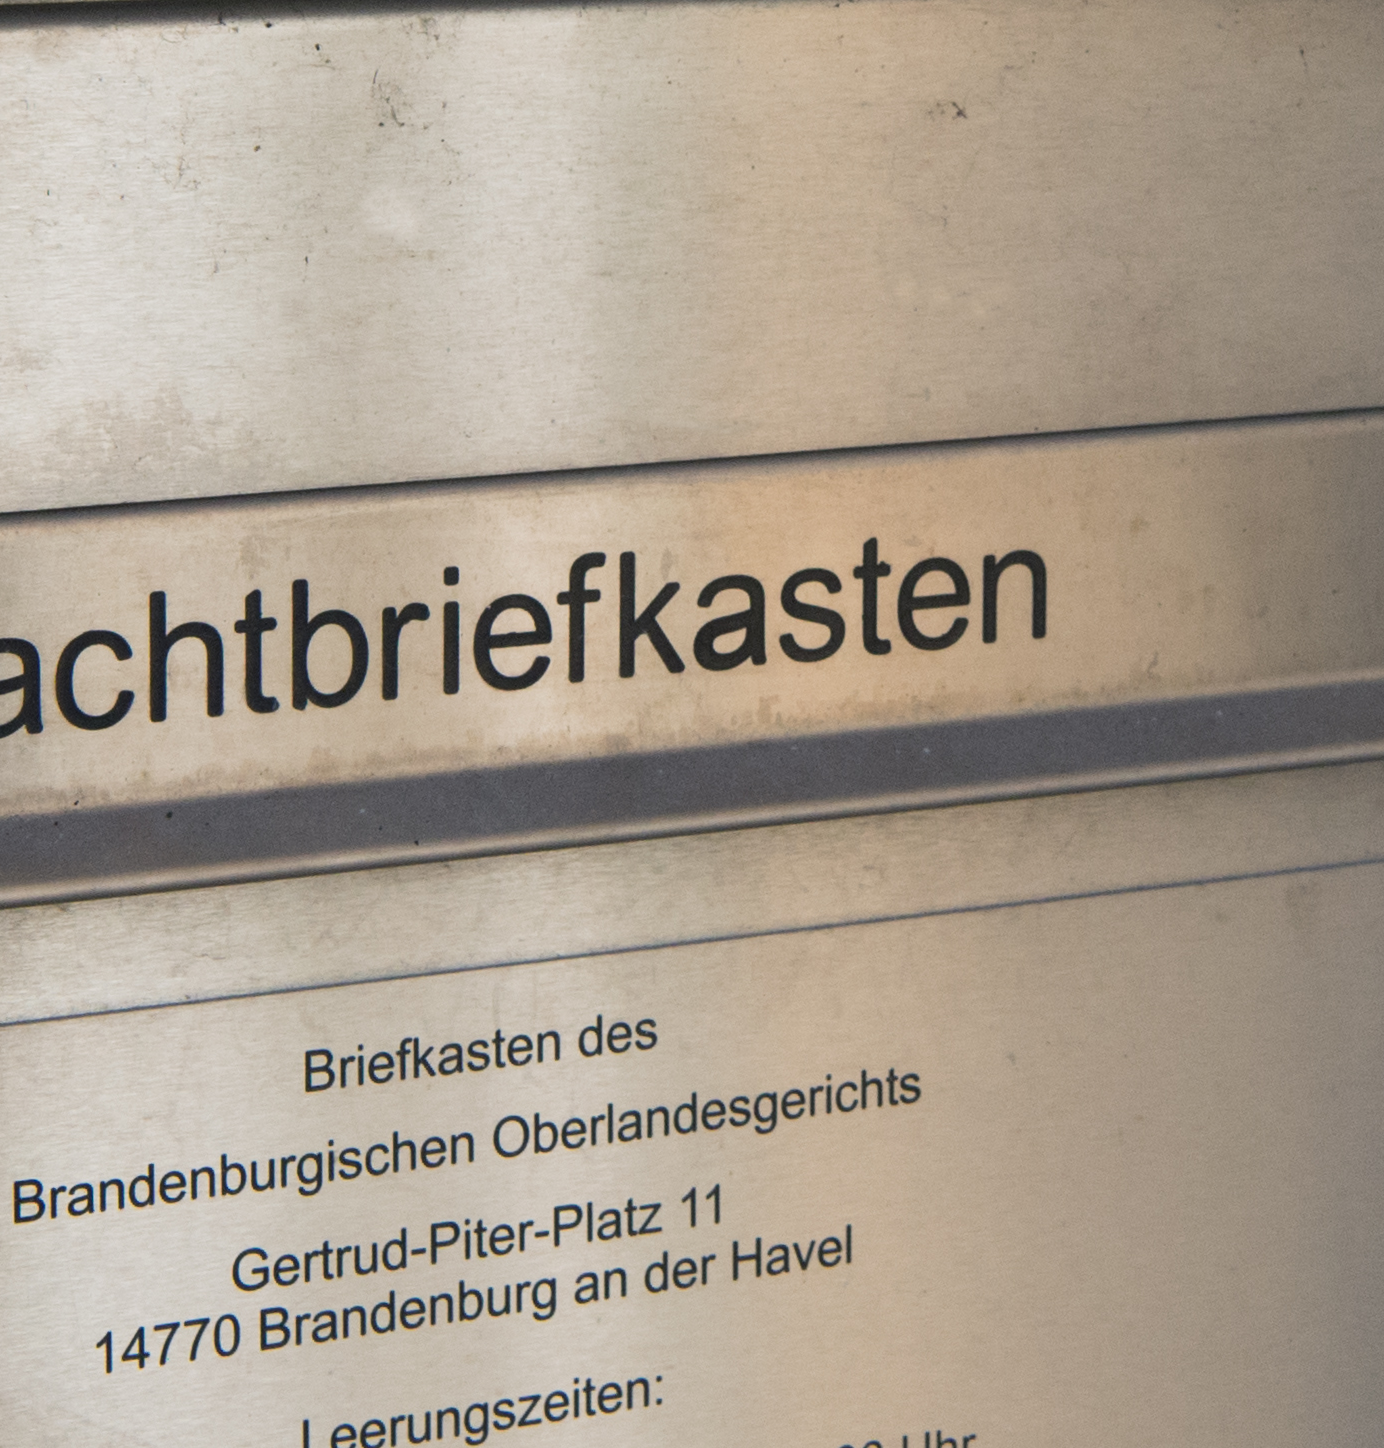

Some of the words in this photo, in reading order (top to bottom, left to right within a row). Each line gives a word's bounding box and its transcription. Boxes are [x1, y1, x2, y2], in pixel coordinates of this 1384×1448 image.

[304, 1029, 561, 1093] Briefkasten
[578, 1014, 658, 1058] des
[13, 1130, 475, 1224] Brandenburgischen
[492, 1065, 923, 1159] Oberlandesgerichts
[94, 1313, 241, 1374] 14770
[258, 1267, 558, 1351] Brandenburg
[574, 1264, 627, 1305] an
[644, 1251, 716, 1294] der
[731, 1224, 853, 1281] Havel
[231, 1200, 663, 1293] Gertrud-Piter-Platz
[681, 1183, 722, 1227] 11
